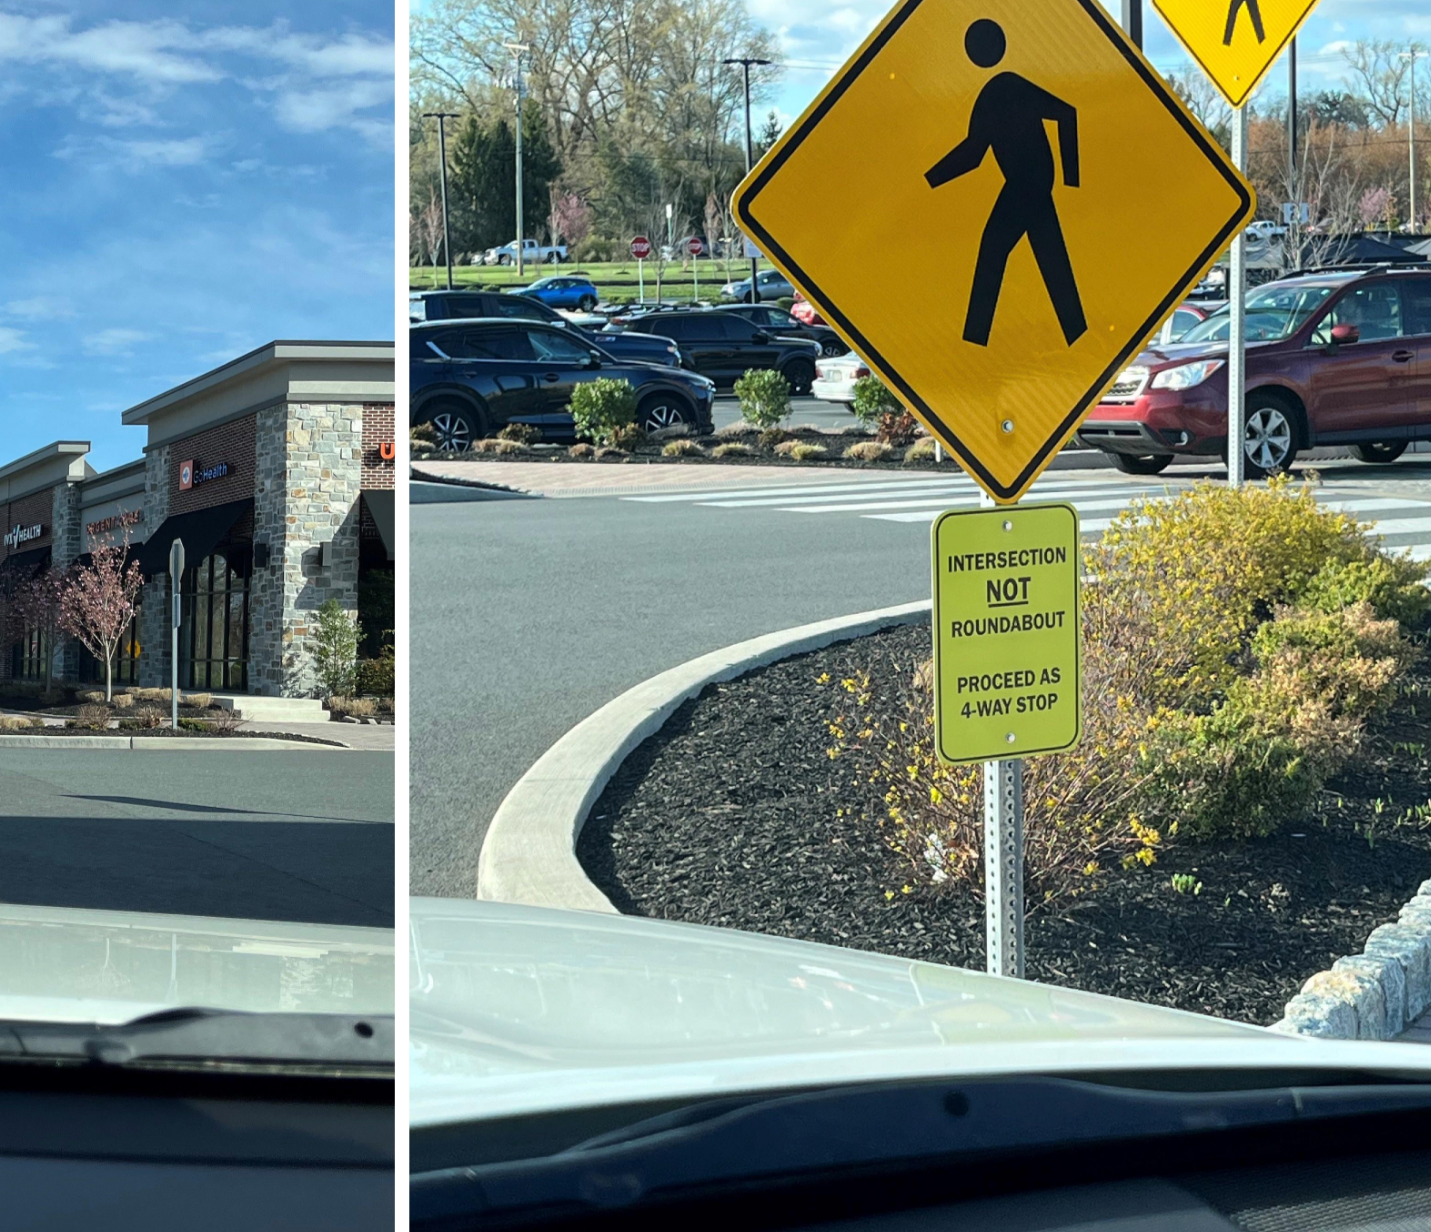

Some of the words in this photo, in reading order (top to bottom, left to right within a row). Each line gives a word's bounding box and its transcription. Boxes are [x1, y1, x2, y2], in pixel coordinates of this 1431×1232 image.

[632, 243, 650, 253] STOP
[193, 462, 228, 484] GoHealth
[19, 524, 42, 543] HEALTH
[948, 546, 1067, 573] INTERSECTION
[986, 576, 1031, 605] NOT
[951, 611, 1066, 638] ROUNDABOUT
[957, 670, 1036, 694] PROCEED
[1040, 667, 1062, 685] AS
[960, 697, 1013, 719] 4-WAY
[1016, 692, 1059, 713] STOP
